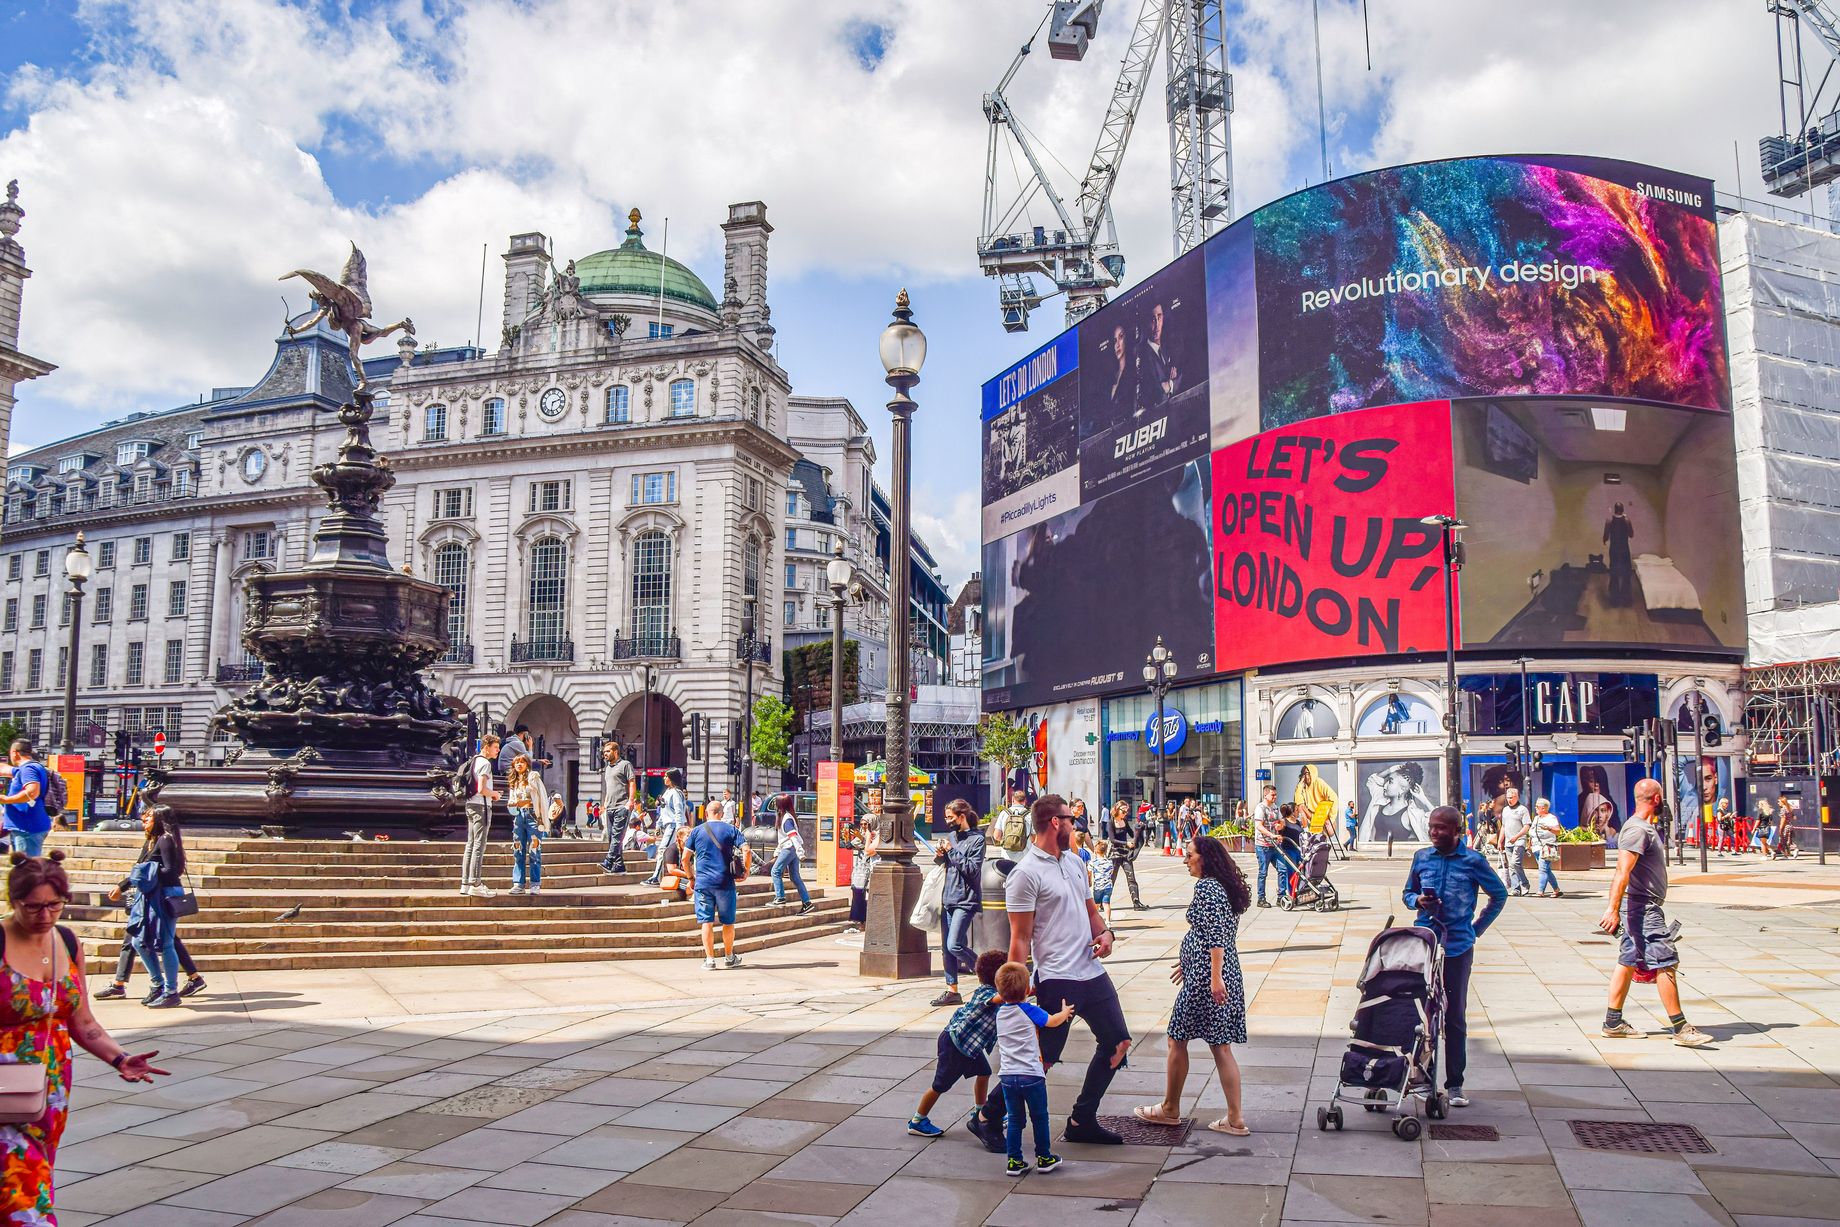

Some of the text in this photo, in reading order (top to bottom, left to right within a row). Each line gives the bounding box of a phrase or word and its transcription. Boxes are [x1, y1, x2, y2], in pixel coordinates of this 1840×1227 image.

[1636, 182, 1702, 208] SAMSUNG
[1302, 259, 1597, 313] Revolutionary design
[1000, 345, 1057, 409] LET'S DO LONDON
[1114, 416, 1168, 459] DUBAI
[1136, 444, 1156, 457] PLAYING
[736, 450, 752, 466] ALLIANCE
[763, 465, 774, 478] OFFICE
[1247, 436, 1400, 493] LET'S
[1001, 492, 1057, 525] #PiccadillyLights
[1221, 491, 1443, 592] OPEN UP,
[1090, 673, 1116, 686] AUGUST
[1537, 681, 1594, 724] GAP
[1106, 731, 1141, 744] pharmacy
[1195, 720, 1224, 735] beauty
